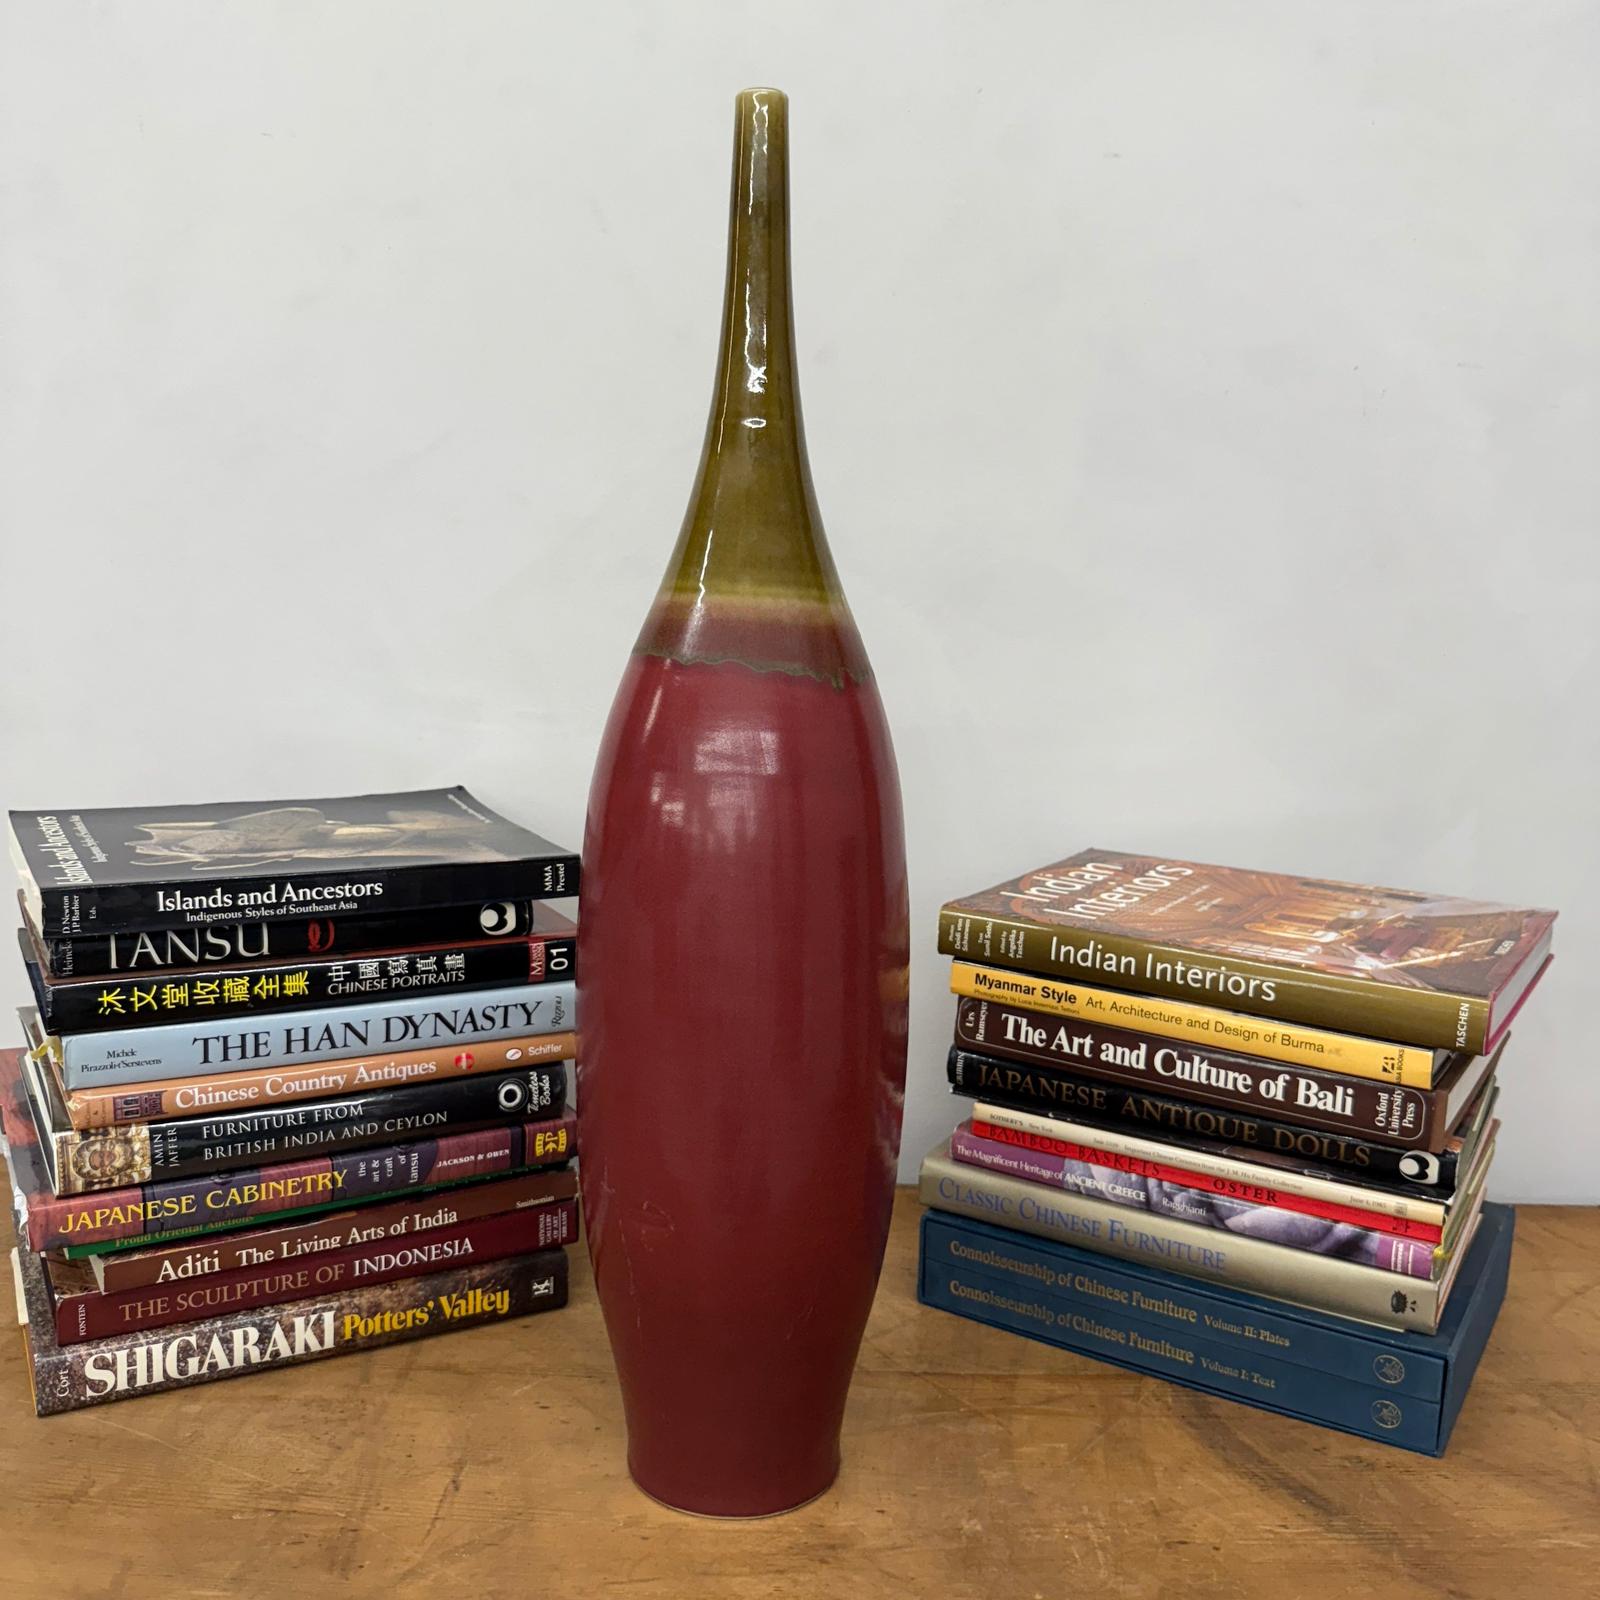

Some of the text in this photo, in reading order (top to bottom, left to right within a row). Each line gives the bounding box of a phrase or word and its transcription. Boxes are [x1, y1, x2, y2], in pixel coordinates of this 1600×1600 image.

[157, 881, 384, 911] Islands and Ancestors
[544, 865, 553, 892] MMA
[556, 863, 565, 892] Prestel
[1000, 860, 1124, 903] Indian
[1044, 863, 1195, 921] Interiors
[186, 900, 358, 924] Indigenous Styles of Southeast Asia
[63, 939, 73, 977] Heineke
[550, 948, 568, 971] 01
[1050, 936, 1137, 976] Indian
[1145, 953, 1277, 1002] Interiors
[98, 970, 309, 1015] 沐文堂收藏全集
[328, 970, 465, 995] CHINESE PORTRAITS
[192, 1000, 543, 1064] THE HAN DYNASTY
[974, 973, 1037, 997] Myanmar
[1041, 985, 1077, 1005] Style
[1085, 996, 1106, 1012] Art,
[1110, 1001, 1182, 1026] Architecture
[1186, 1015, 1210, 1030] and
[1214, 1020, 1259, 1042] Design
[1264, 1031, 1277, 1044] of
[1280, 1034, 1325, 1054] Burma
[1455, 1002, 1469, 1048] TASCHEN
[528, 1043, 562, 1056] Schiffer
[1001, 1013, 1355, 1117] The Art and Culture of Bali
[175, 1061, 436, 1109] Chinese Country Antiques
[540, 1074, 551, 1106] Books
[203, 1103, 364, 1139] FURNITURE FROM
[979, 1064, 1107, 1110] JAPANESE
[1121, 1096, 1259, 1144] ANTIQUE
[1274, 1127, 1371, 1167] DOLLS
[1375, 1092, 1389, 1127] Oxford
[1388, 1089, 1404, 1136] University
[1403, 1102, 1416, 1129] Press
[153, 1133, 164, 1167] AMIN
[168, 1127, 178, 1168] JAFFER
[204, 1111, 448, 1161] BRITISH INDIA AND CEYLON
[990, 1123, 1161, 1177] BAMBOO BASKETS
[358, 1161, 366, 1177] the
[373, 1159, 380, 1167] &
[386, 1157, 394, 1177] craft
[400, 1155, 407, 1164] of
[436, 1149, 510, 1168] JACKSON & OWEN
[957, 1145, 1146, 1201] The Magnificent Heritage of ANCIENT GREECE
[59, 1169, 348, 1234] JAPANESE CABINETRY
[1213, 1179, 1279, 1203] OSTER
[115, 1233, 151, 1248] Proud
[155, 1223, 203, 1239] Oriental
[939, 1176, 1226, 1271] CLASSIC CHINESE FURNITURE
[156, 1208, 458, 1284] Aditi The Living Arts of India
[119, 1236, 474, 1322] THE SCULPTURE OF INDONESIA
[951, 1241, 1291, 1347] Connoisseurship of Chinese Furniture Volume II: Plates
[84, 1311, 336, 1398] SHIGARAKI
[439, 1288, 511, 1320] Valley
[950, 1280, 1054, 1324] Connoisseurship
[1057, 1312, 1072, 1326] of
[1072, 1316, 1125, 1344] Chinese
[1128, 1332, 1194, 1364] Furniture
[1200, 1357, 1238, 1379] Volume
[1250, 1372, 1277, 1389] Text
[57, 1369, 69, 1397] Cort
